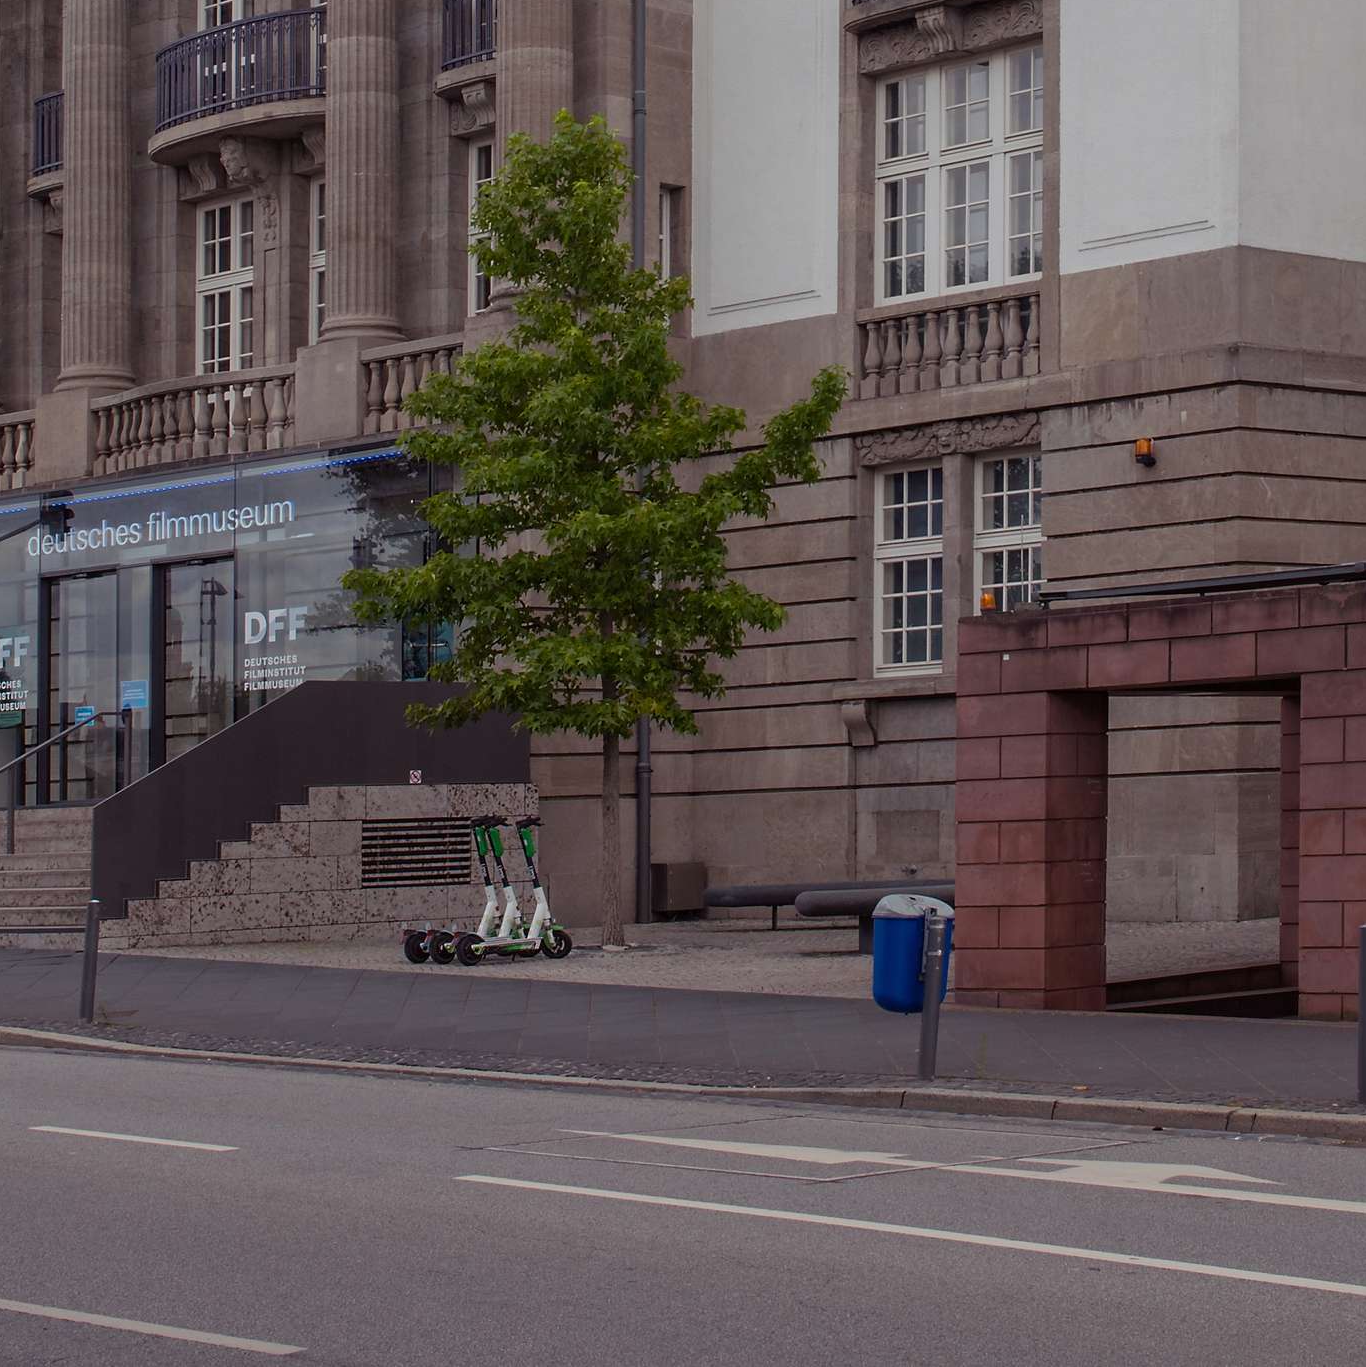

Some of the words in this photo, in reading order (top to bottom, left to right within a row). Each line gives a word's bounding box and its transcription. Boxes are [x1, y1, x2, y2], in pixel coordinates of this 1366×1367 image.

[28, 519, 140, 557] deutsches
[146, 500, 295, 542] filmmuseum
[245, 606, 308, 644] DFF
[244, 654, 298, 667] DEUTSCHES
[244, 666, 306, 679] FILMINSTITUT
